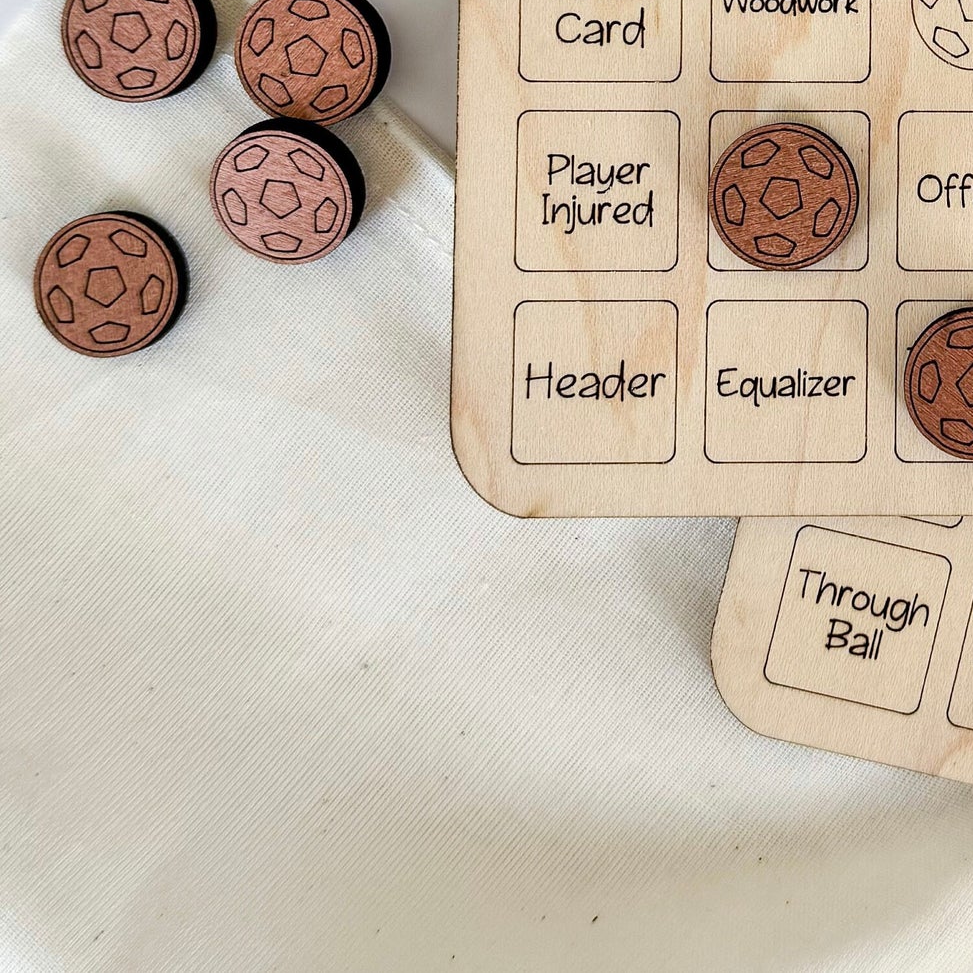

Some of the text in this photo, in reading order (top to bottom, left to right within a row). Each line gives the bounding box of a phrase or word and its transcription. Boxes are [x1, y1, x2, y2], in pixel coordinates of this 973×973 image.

[556, 7, 645, 48] Card
[546, 154, 651, 193] Player
[542, 191, 654, 231] Injured
[525, 359, 666, 402] Header
[717, 368, 856, 400] Equalizer
[799, 568, 930, 632] Through
[825, 618, 884, 661] Ball
